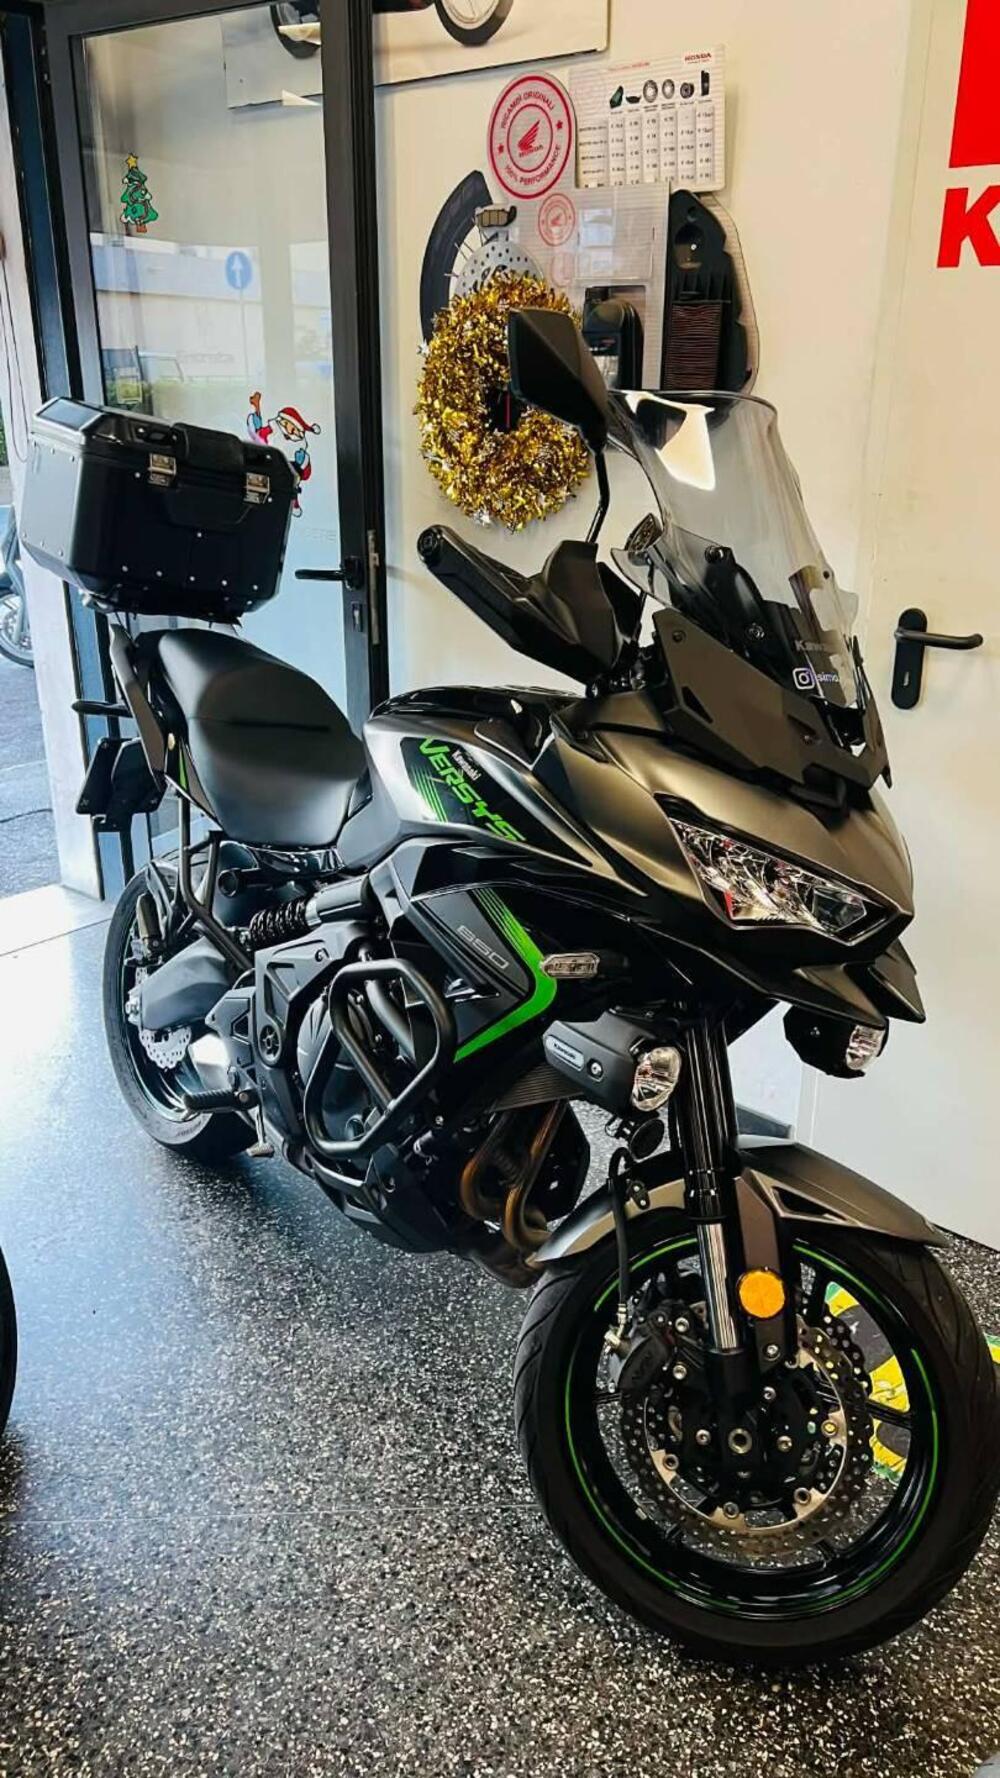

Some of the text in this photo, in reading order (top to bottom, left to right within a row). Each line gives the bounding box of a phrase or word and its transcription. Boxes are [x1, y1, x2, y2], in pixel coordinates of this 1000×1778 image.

[685, 53, 712, 61] HONDA
[501, 91, 555, 129] RICAMBI ORIGINALI
[519, 144, 561, 186] PERFORMANCE
[452, 750, 481, 781] Kawasaki
[419, 736, 527, 842] VERSYS
[457, 925, 510, 969] 650
